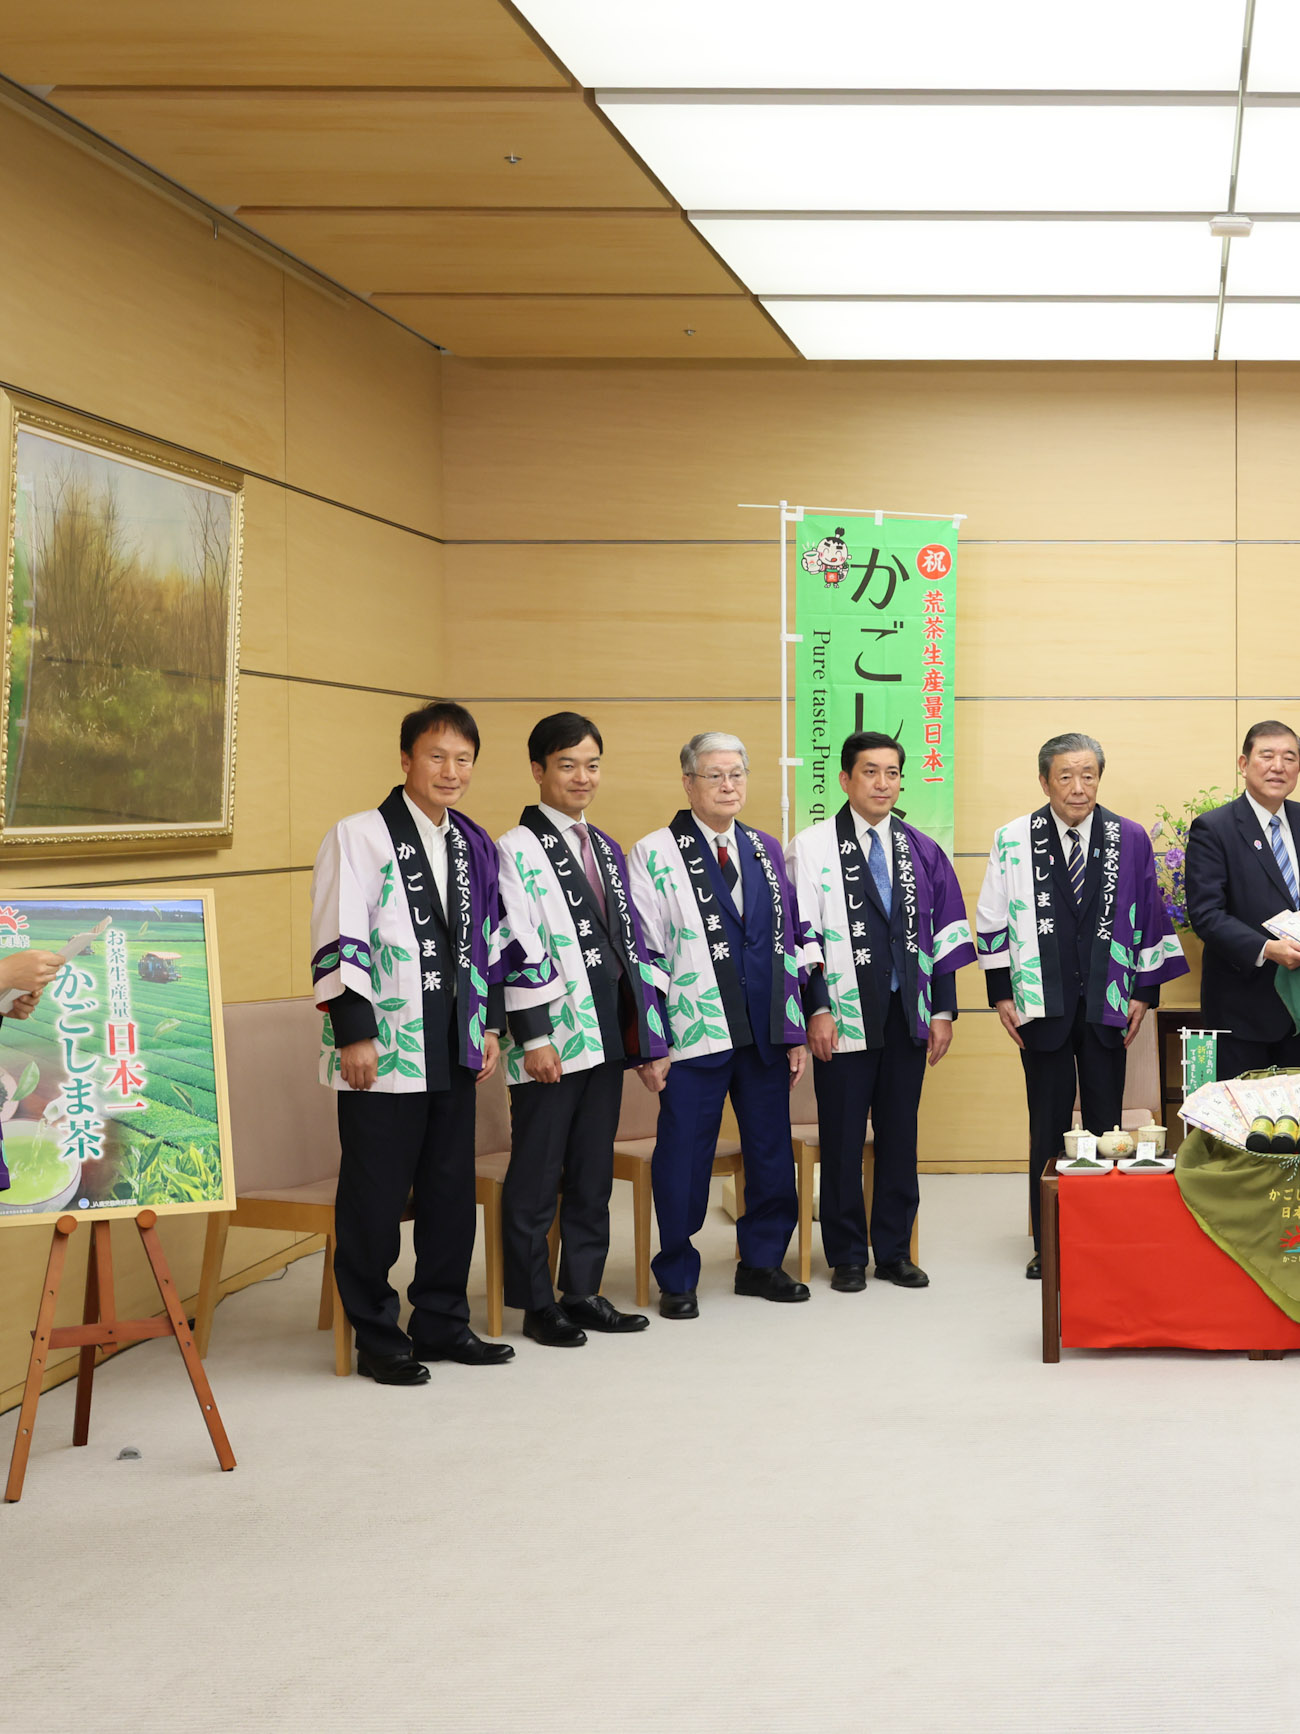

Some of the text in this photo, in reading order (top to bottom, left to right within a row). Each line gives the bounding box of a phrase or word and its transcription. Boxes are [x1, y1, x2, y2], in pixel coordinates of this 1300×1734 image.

[812, 630, 831, 679] Pure
[850, 548, 910, 820] かごし
[922, 550, 946, 783] 祝 荒茶生産量日本一
[397, 842, 442, 992] かごしま茶
[540, 833, 602, 969] かごしま茶
[677, 834, 730, 962] かごしま茶
[839, 840, 872, 966] かごしま茶
[893, 831, 919, 953] 安全・安心でクリーンな
[1031, 816, 1055, 935] かごしま茶
[1097, 820, 1121, 941] 安全・安心でクリーンな
[54, 964, 102, 1160] かごしま茶
